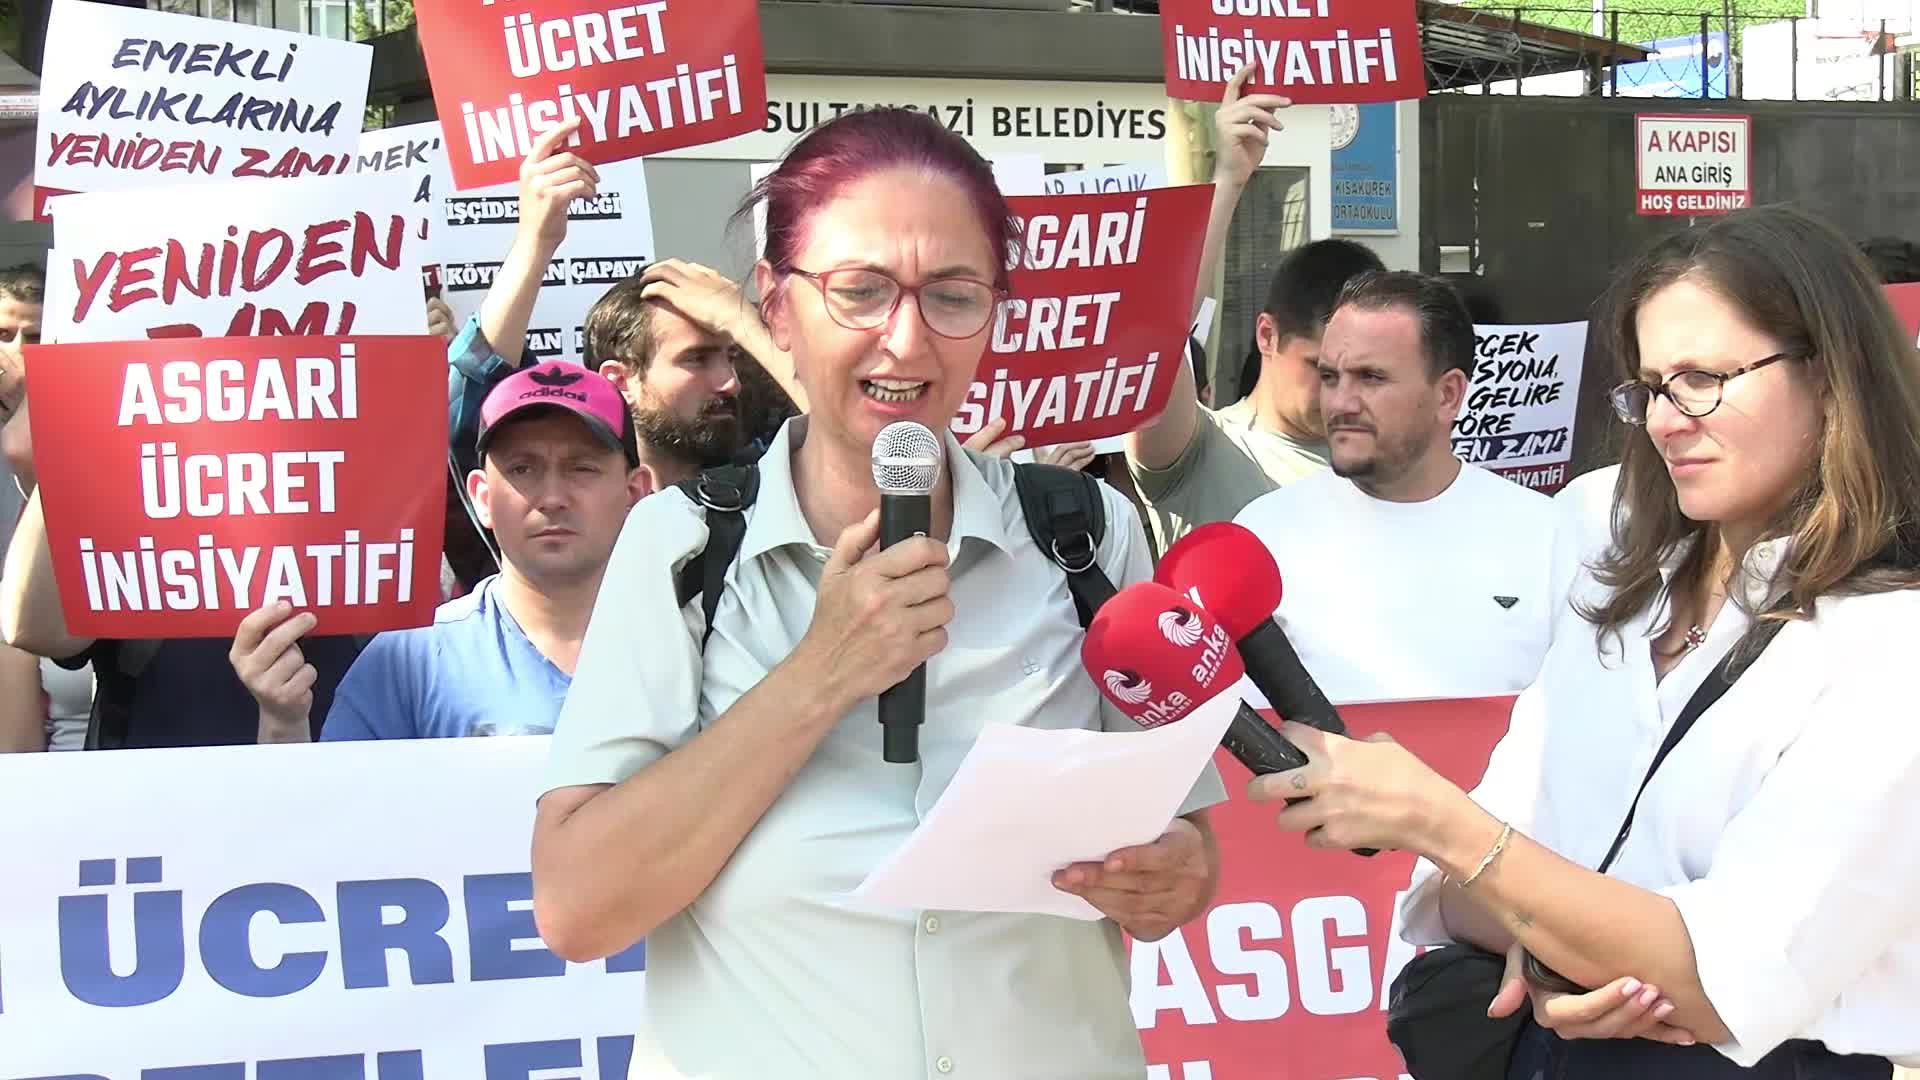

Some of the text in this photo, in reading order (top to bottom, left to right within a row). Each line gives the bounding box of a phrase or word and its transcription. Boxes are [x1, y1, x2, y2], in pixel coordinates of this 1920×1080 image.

[112, 38, 299, 83] EMEKLİ
[504, 1, 669, 79] ÜCRET
[1175, 24, 1398, 86] İNİSİYATİFİ
[61, 81, 342, 137] AYLIKLARINA
[462, 54, 743, 165] İNİSİYATİFİ
[47, 131, 222, 176] YENİDEN
[1648, 131, 1737, 153] A KAPISI
[1641, 191, 1747, 214] HOŞ GELDİNİZ
[1655, 161, 1733, 188] ANA GİRİŞ
[447, 197, 520, 224] İŞÇİDE
[1004, 197, 1148, 271] SGARİ
[73, 211, 405, 324] YENİDEN
[991, 292, 1121, 353] CRET
[118, 343, 358, 426] ASGARİ
[951, 352, 1160, 434] SİYATİFİ
[1467, 382, 1564, 412] GELİRE
[1451, 411, 1516, 437] ÖRE
[141, 442, 345, 519] ÜCRET
[79, 528, 415, 611] İNİSİYATİFİ
[1191, 624, 1225, 683] anka
[1134, 691, 1188, 725] anka
[58, 855, 646, 1008] ÜCRE
